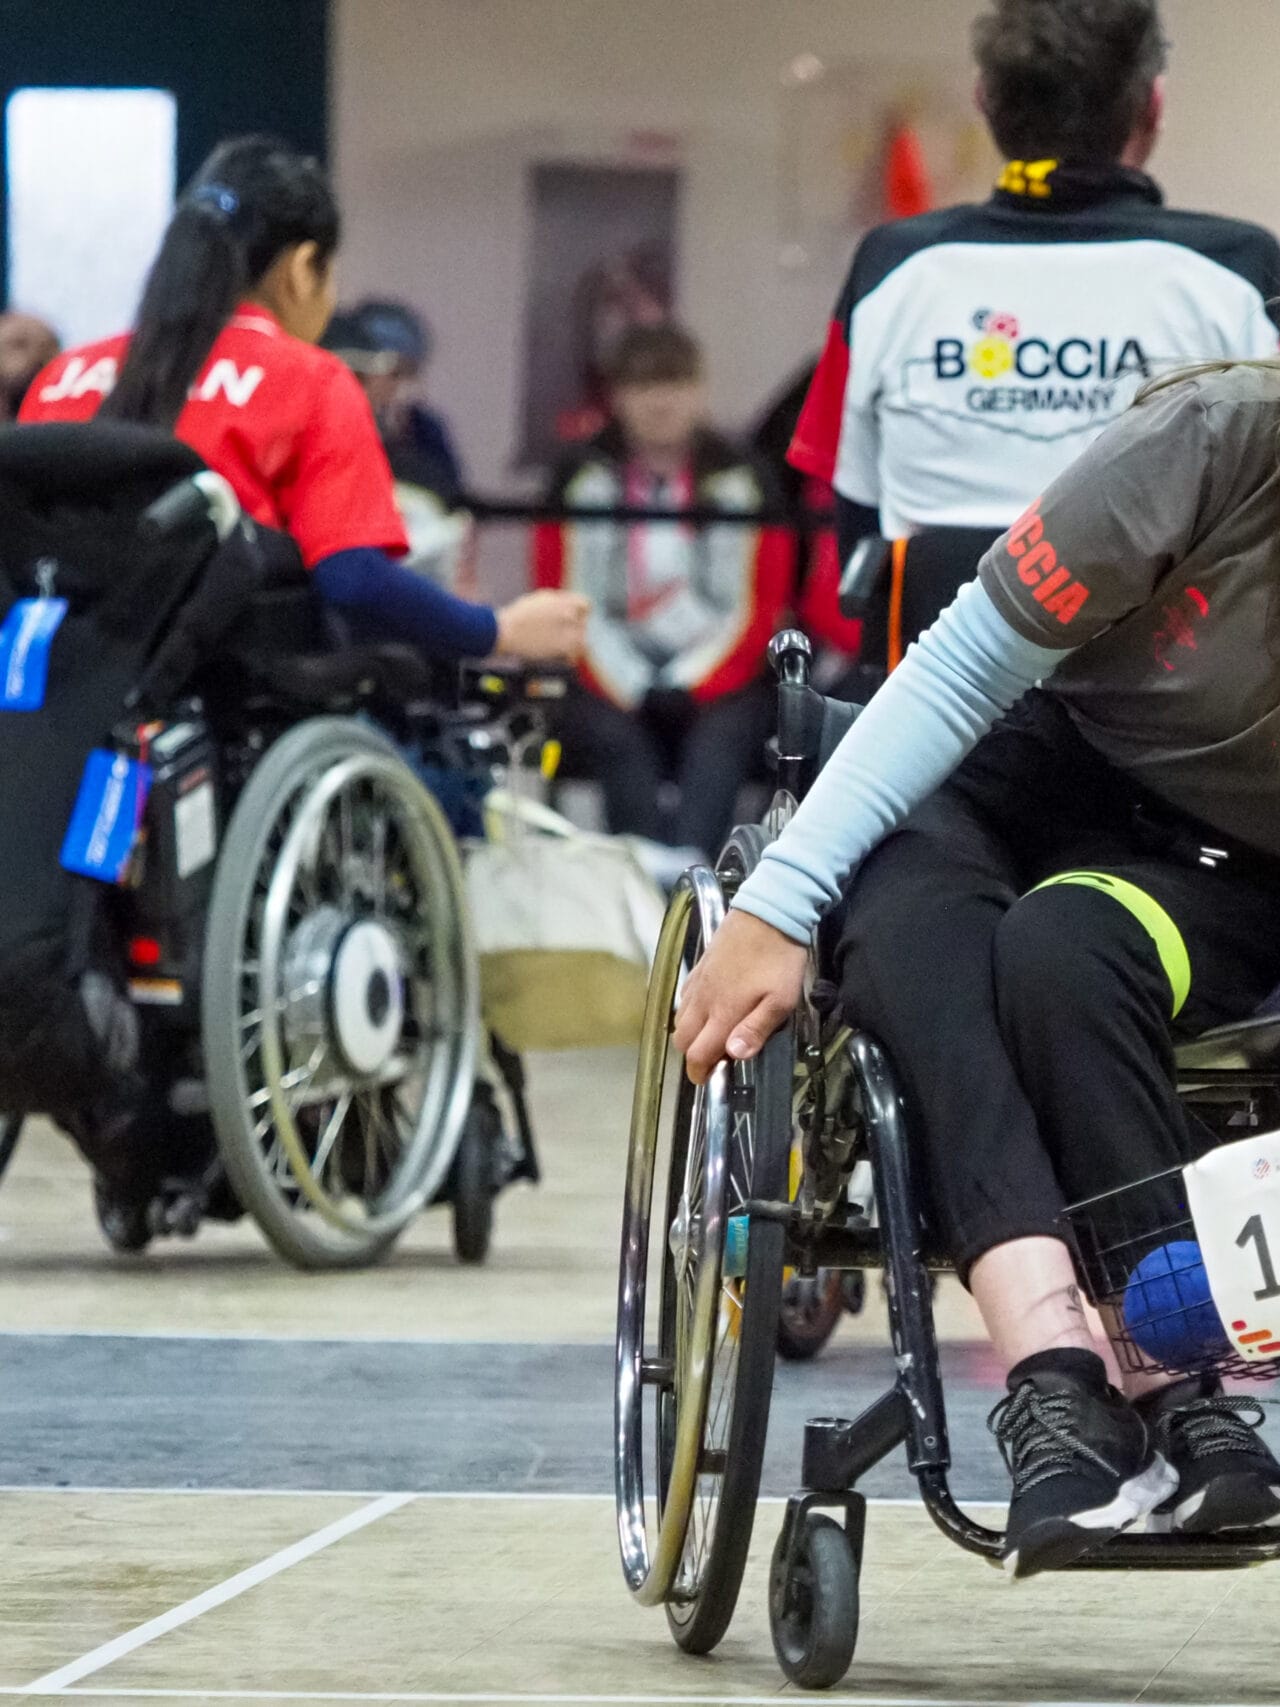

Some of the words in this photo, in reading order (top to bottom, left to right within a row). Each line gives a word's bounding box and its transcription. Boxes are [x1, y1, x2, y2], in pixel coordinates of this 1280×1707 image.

[39, 355, 265, 408] JAN
[966, 387, 1115, 413] GERMANY
[1006, 495, 1091, 625] CCIA
